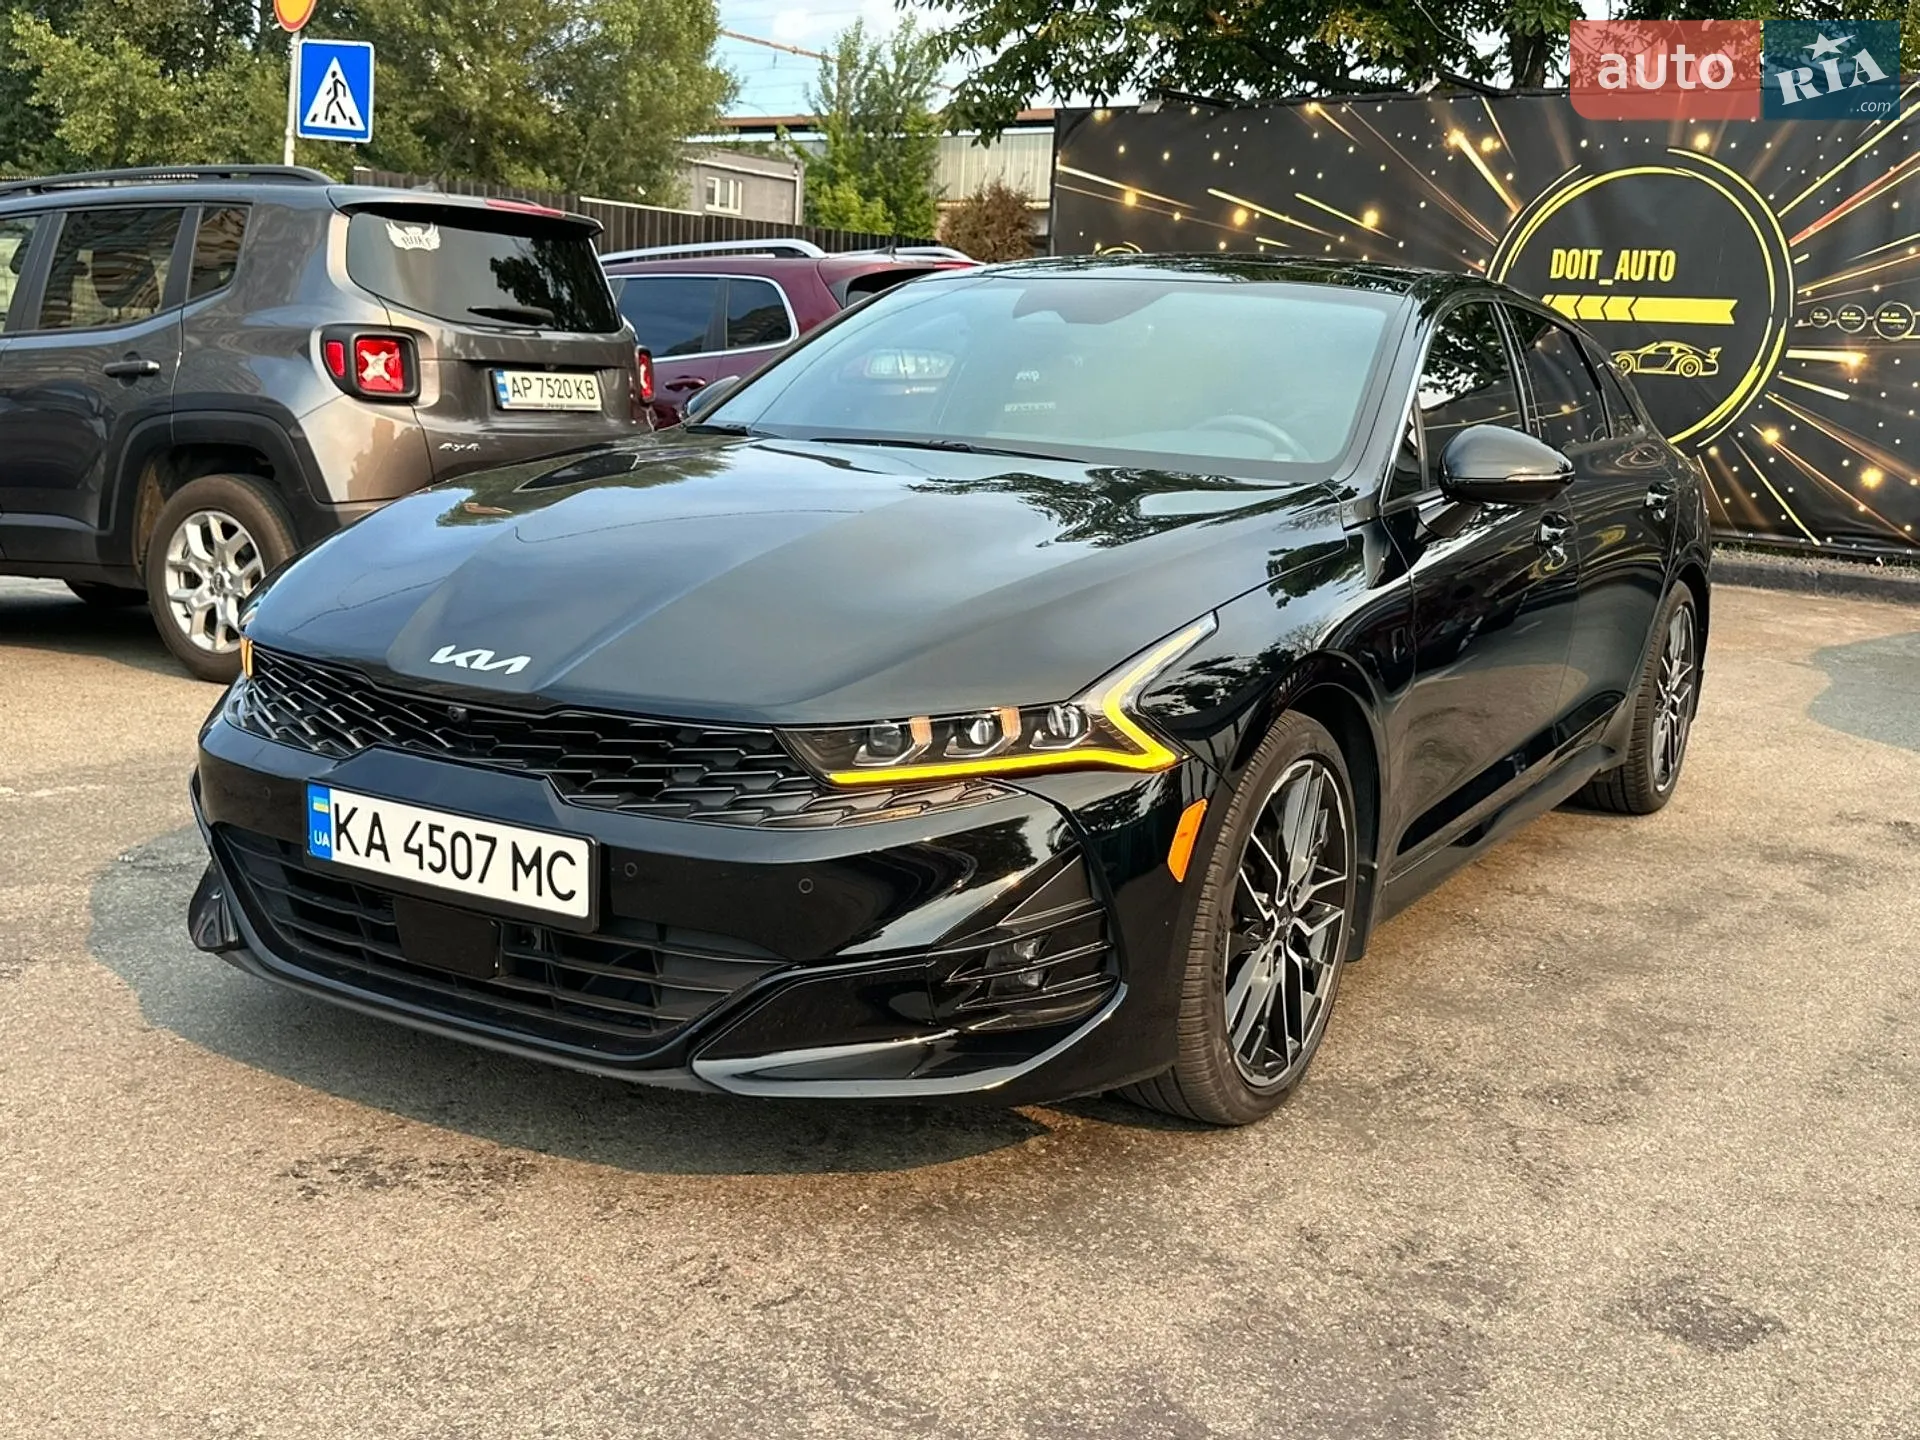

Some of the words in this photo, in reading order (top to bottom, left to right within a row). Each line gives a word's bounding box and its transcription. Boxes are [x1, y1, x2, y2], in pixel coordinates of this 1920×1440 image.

[1550, 248, 1676, 286] DOIT_AUTO
[511, 376, 532, 399] AP
[535, 377, 572, 400] 7520
[574, 378, 596, 400] KB
[314, 830, 330, 848] UA
[334, 802, 391, 863] KA
[403, 820, 497, 884] 4507
[511, 840, 577, 902] MC
